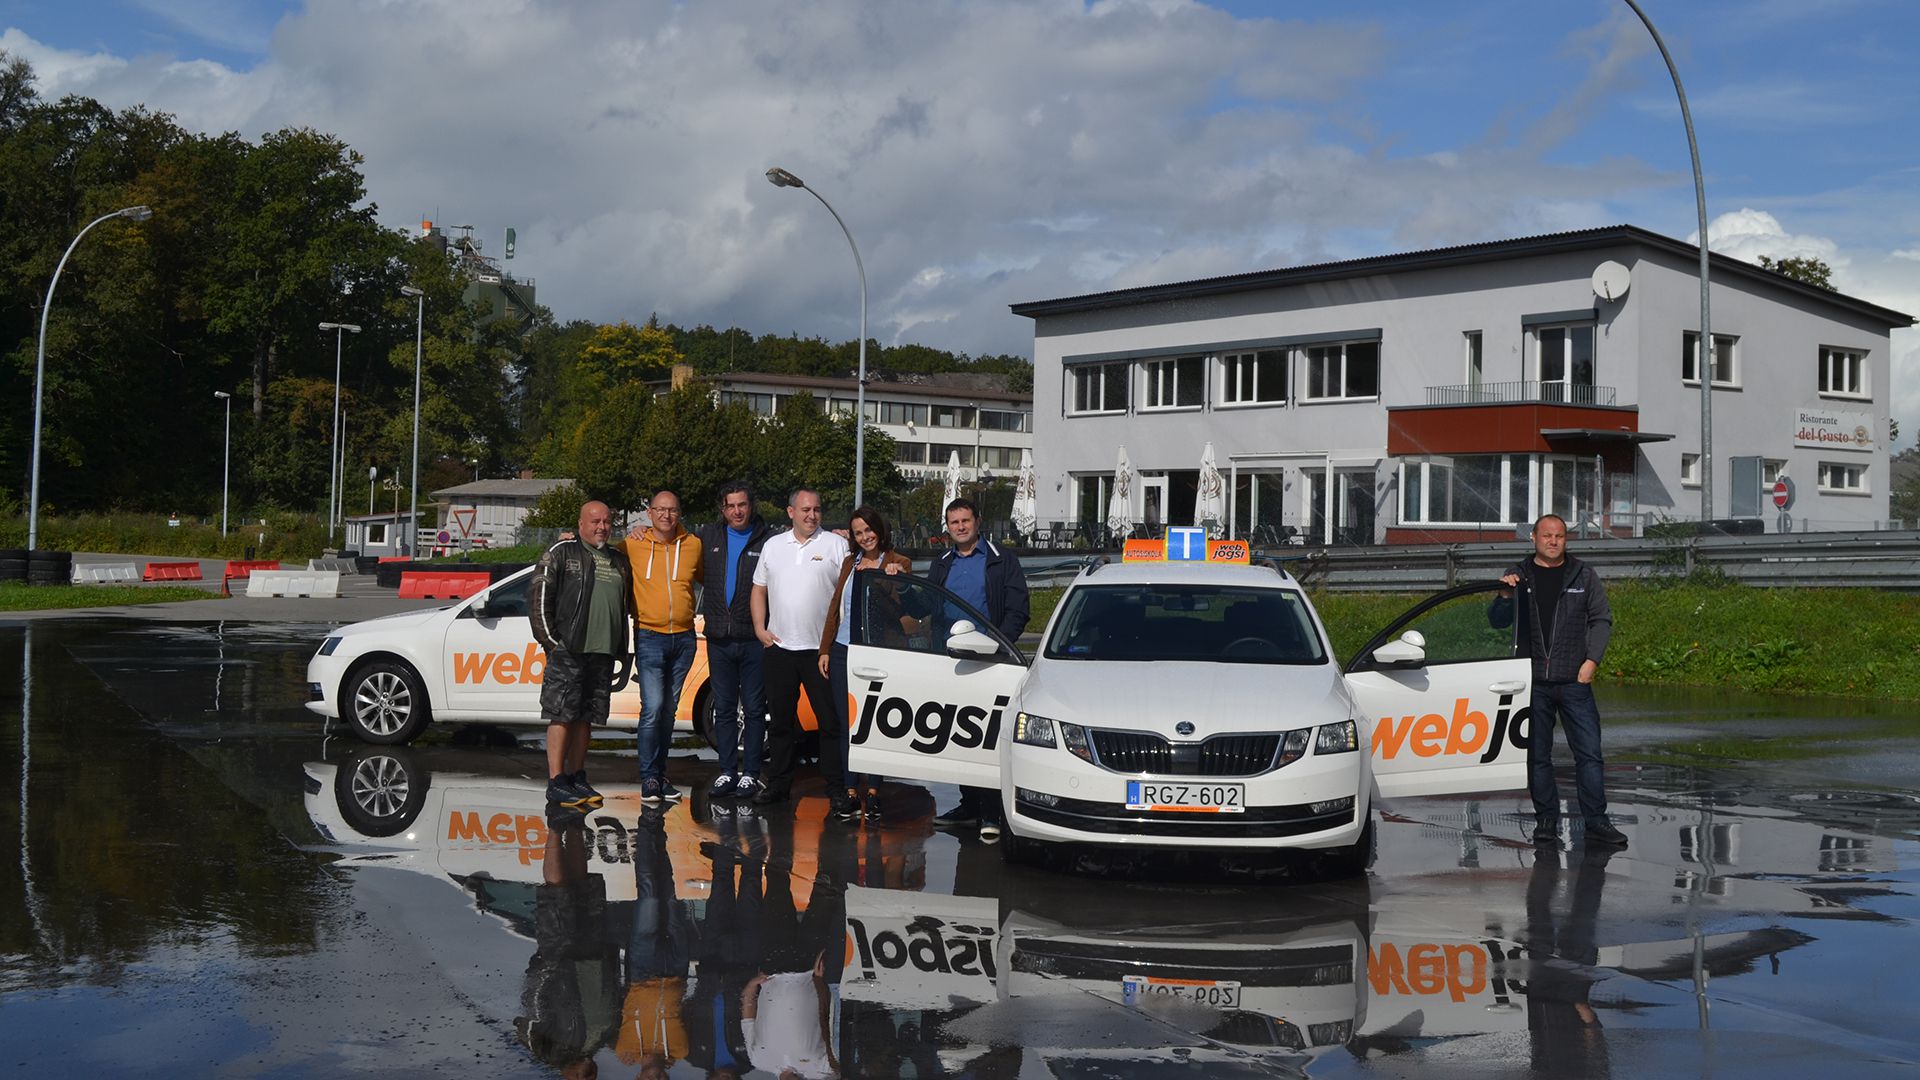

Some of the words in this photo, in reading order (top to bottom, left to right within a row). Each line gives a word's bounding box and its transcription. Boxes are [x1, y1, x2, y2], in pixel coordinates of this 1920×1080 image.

[1800, 413, 1838, 425] Ristorante
[1799, 427, 1814, 441] del
[1818, 428, 1849, 443] Gusto
[1170, 528, 1203, 559] T
[1213, 547, 1246, 560] jogsi
[1144, 786, 1238, 806] RGZ-602
